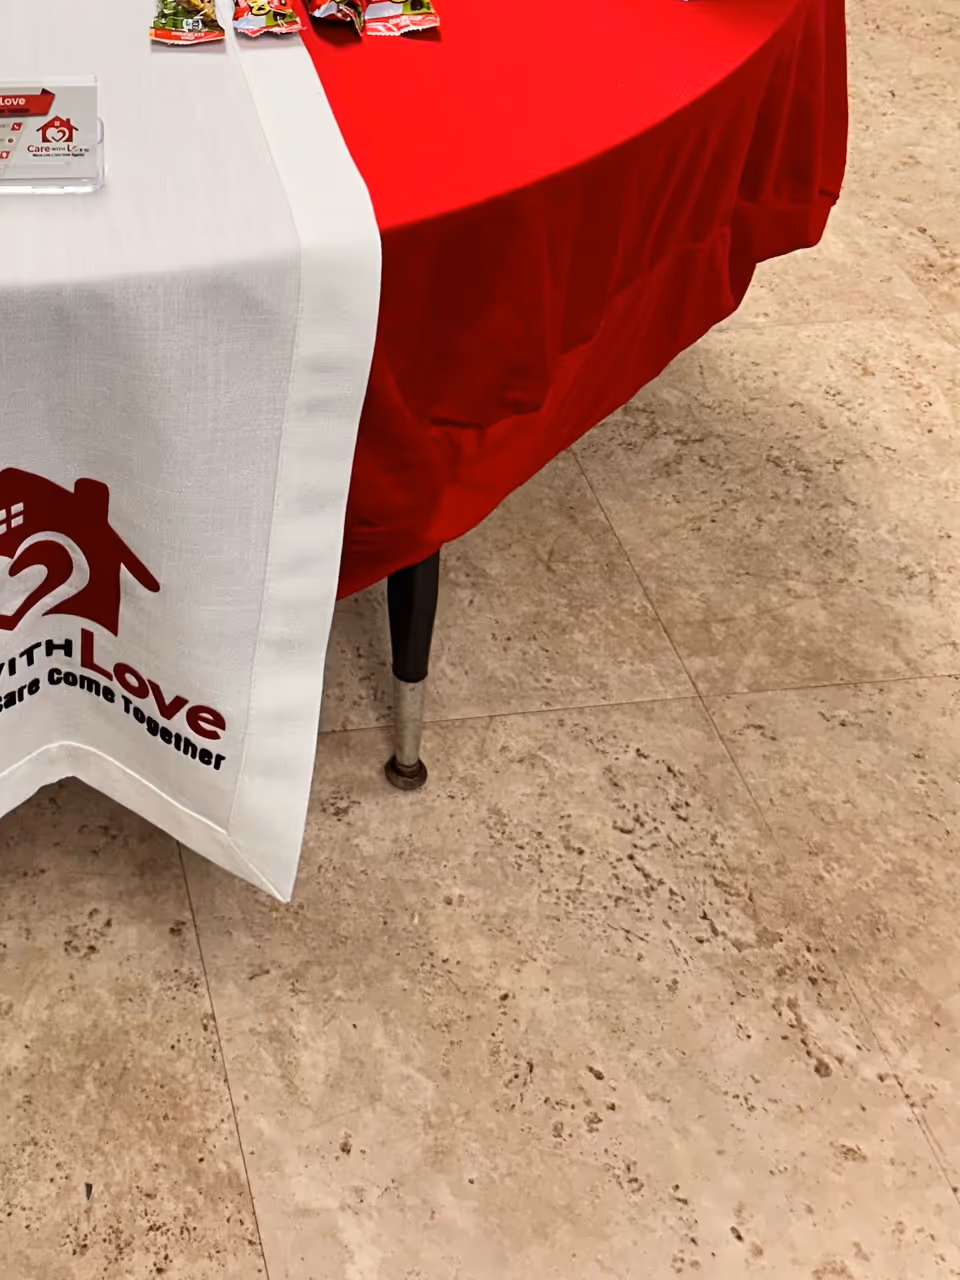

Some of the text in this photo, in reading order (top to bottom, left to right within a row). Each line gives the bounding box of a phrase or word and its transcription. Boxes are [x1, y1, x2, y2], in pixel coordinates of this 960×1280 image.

[0, 96, 26, 106] Love
[27, 144, 51, 152] Care
[81, 628, 226, 740] Love
[47, 667, 115, 705] Come
[121, 692, 226, 771] Together
